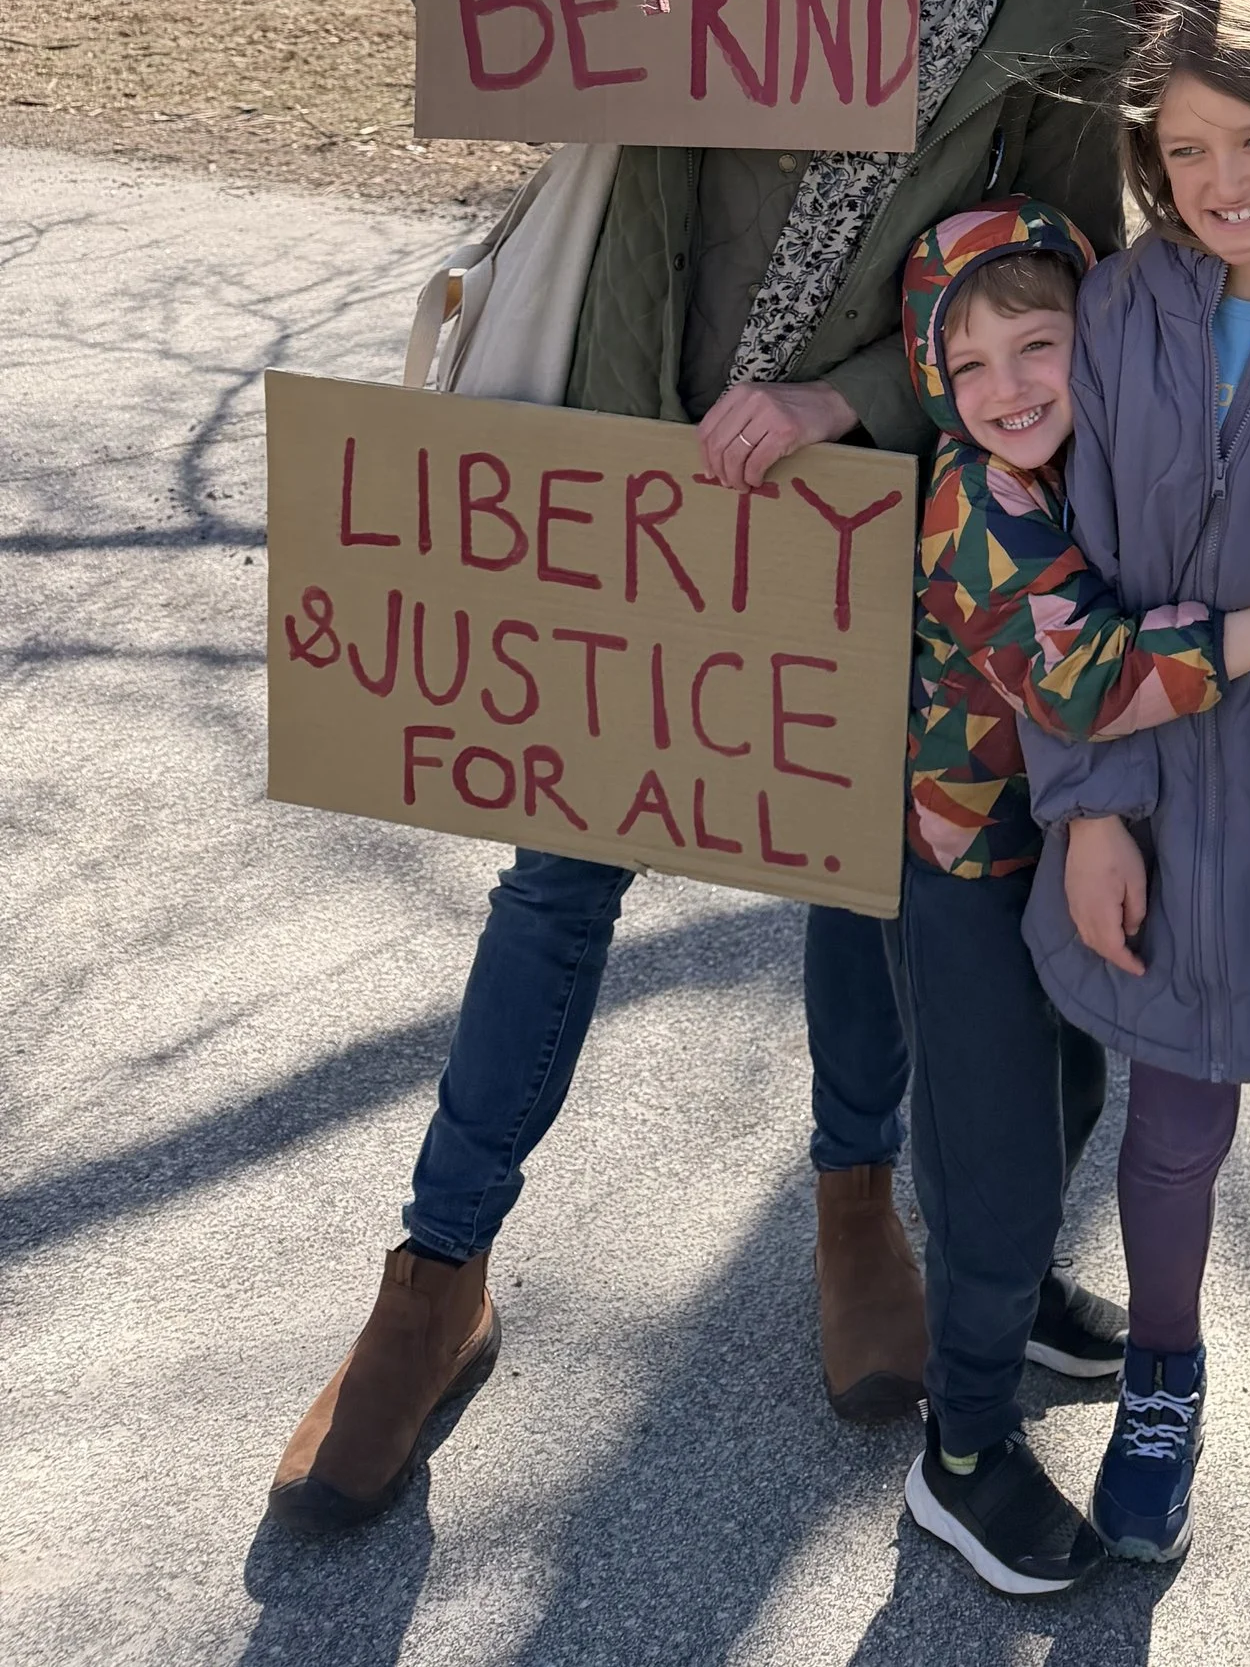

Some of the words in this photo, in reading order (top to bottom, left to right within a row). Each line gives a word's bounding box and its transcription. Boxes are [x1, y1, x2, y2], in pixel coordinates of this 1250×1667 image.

[339, 436, 903, 633] LIBERTY
[403, 725, 589, 832] FOR
[617, 769, 842, 874] ALL.
